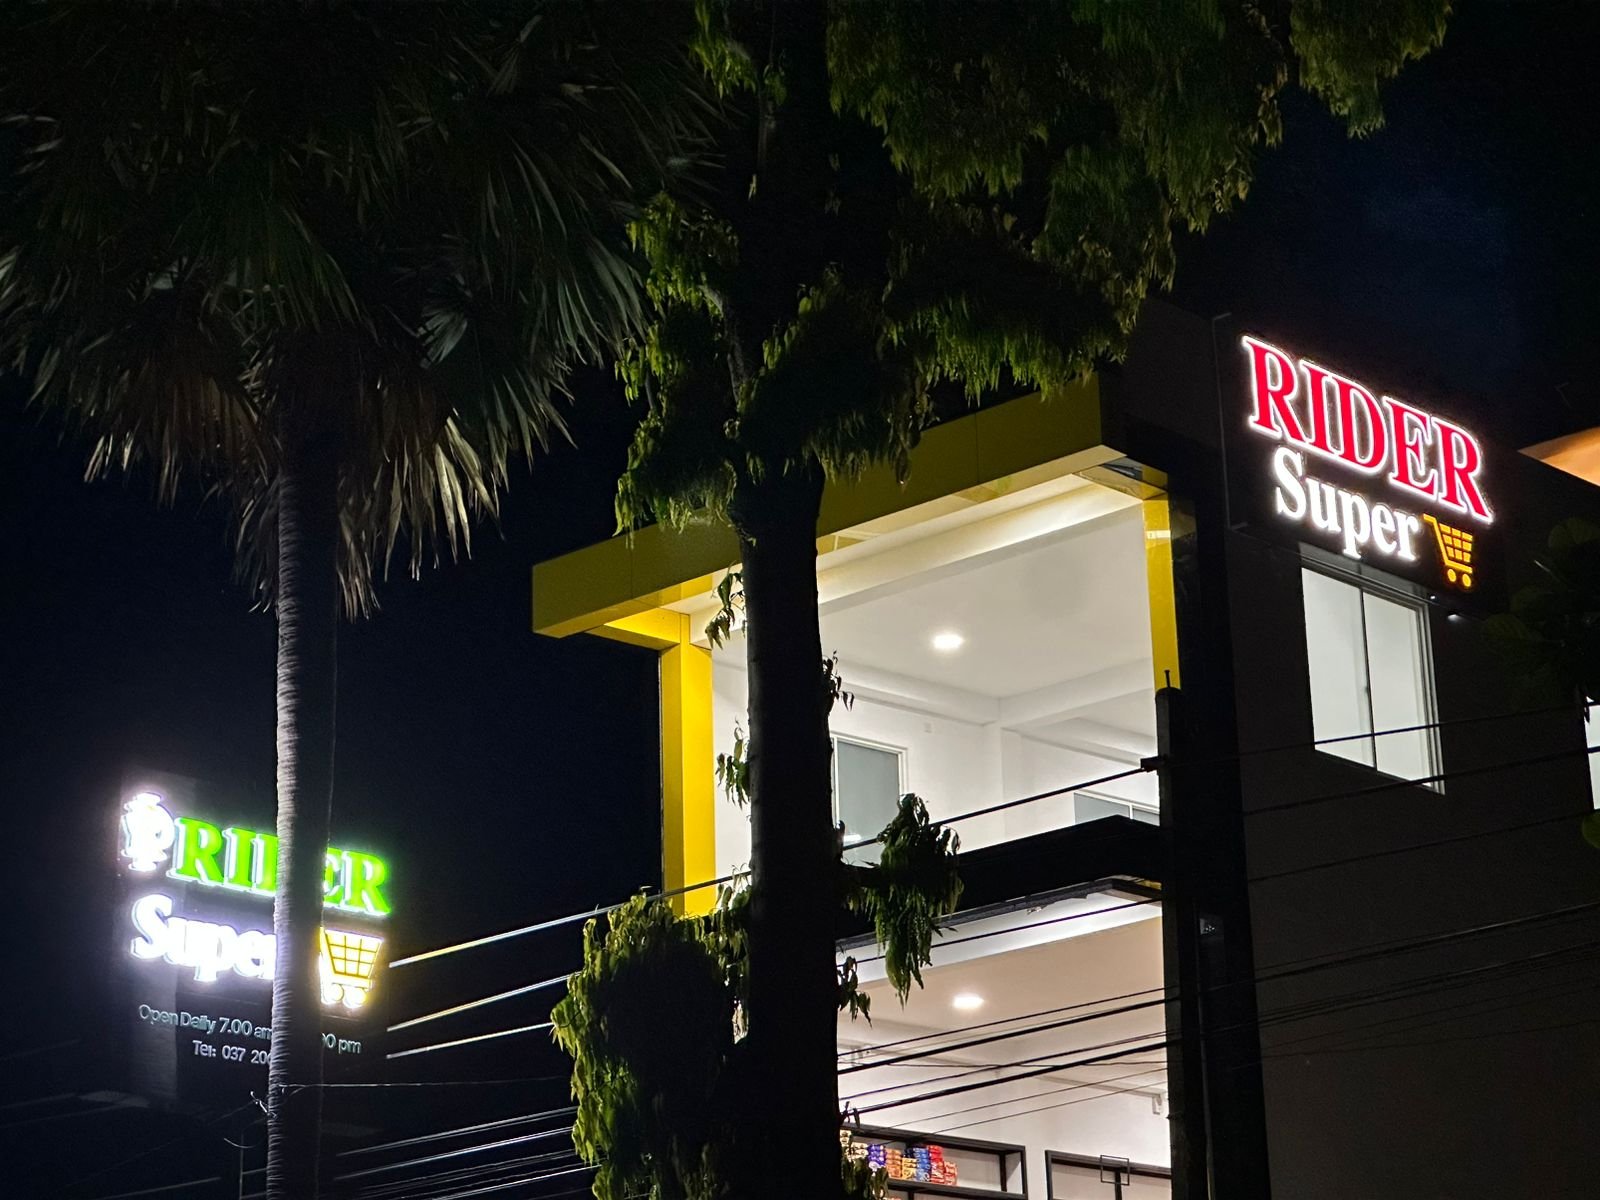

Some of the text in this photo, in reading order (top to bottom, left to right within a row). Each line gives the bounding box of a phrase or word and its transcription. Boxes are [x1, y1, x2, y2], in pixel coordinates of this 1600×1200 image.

[1241, 335, 1494, 525] RIDER
[1273, 446, 1420, 561] Super
[166, 815, 391, 917] RIER
[138, 1003, 179, 1026] Open
[180, 1011, 217, 1035] Daily
[218, 1016, 253, 1037] 7.00
[337, 1036, 362, 1055] pm
[192, 1039, 217, 1058] Tel:
[221, 1045, 247, 1063] 037
